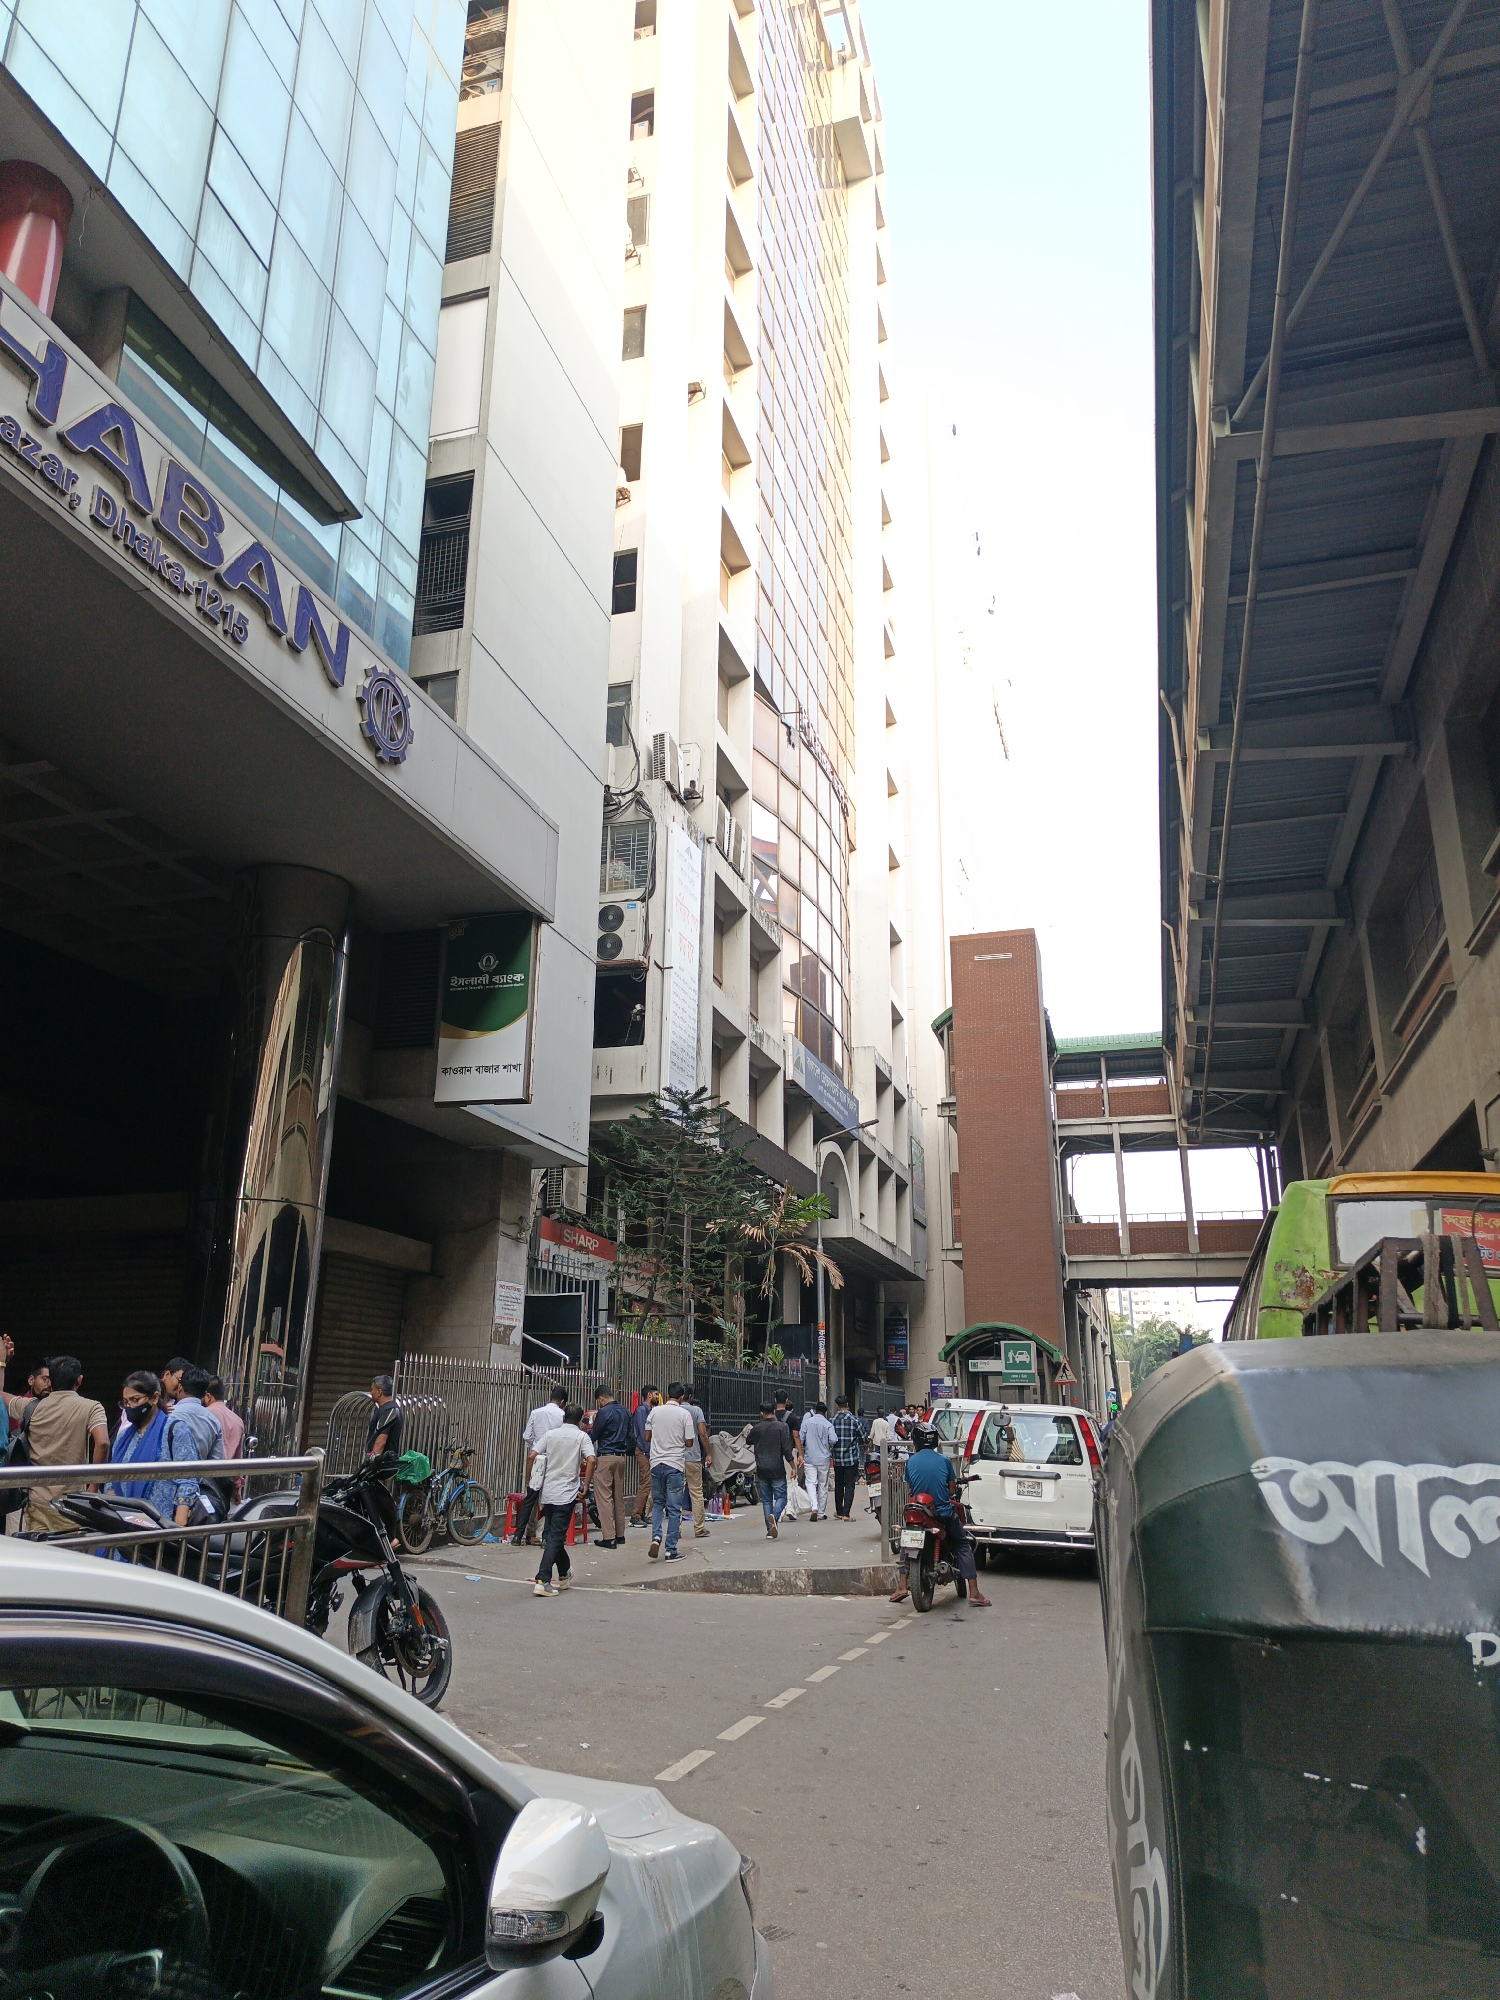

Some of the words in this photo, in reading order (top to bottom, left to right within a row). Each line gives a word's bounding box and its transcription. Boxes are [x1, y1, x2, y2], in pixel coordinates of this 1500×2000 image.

[90, 484, 250, 646] Dhaka-1215
[450, 973, 489, 987] ইসলামী
[491, 973, 525, 984] ব্যাংক
[441, 1066, 473, 1076] কাওরান
[475, 1064, 501, 1075] বাজার
[502, 1063, 522, 1073] শাখা
[563, 1228, 600, 1251] SHARP
